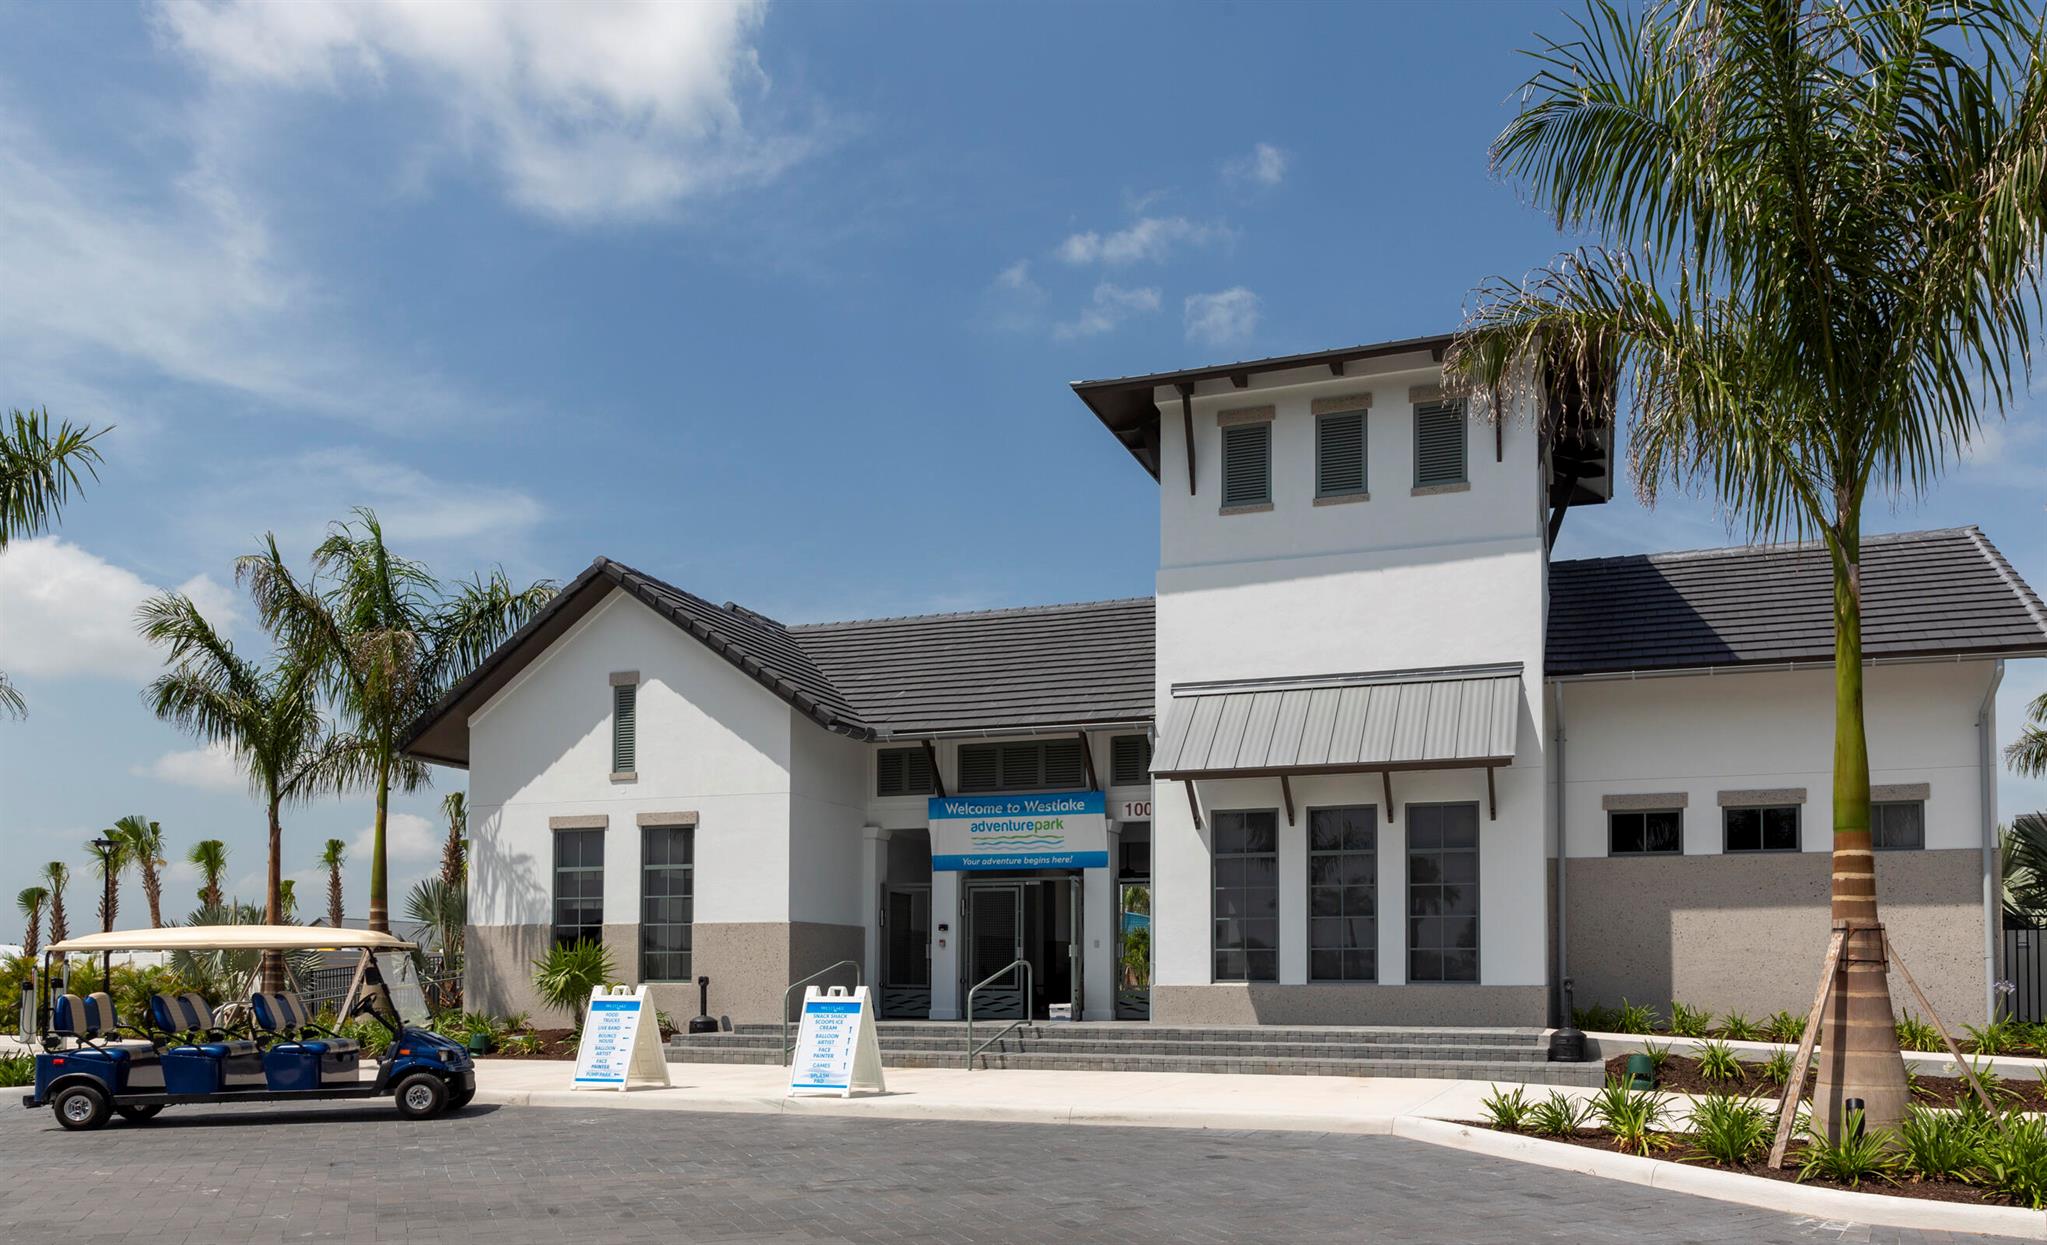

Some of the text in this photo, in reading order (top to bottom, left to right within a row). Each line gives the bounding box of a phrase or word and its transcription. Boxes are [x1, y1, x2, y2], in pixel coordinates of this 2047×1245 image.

[945, 799, 1085, 815] Welcome to Westlake
[970, 818, 1064, 833] adventurepark
[962, 855, 1073, 866] Your adventure begins here!
